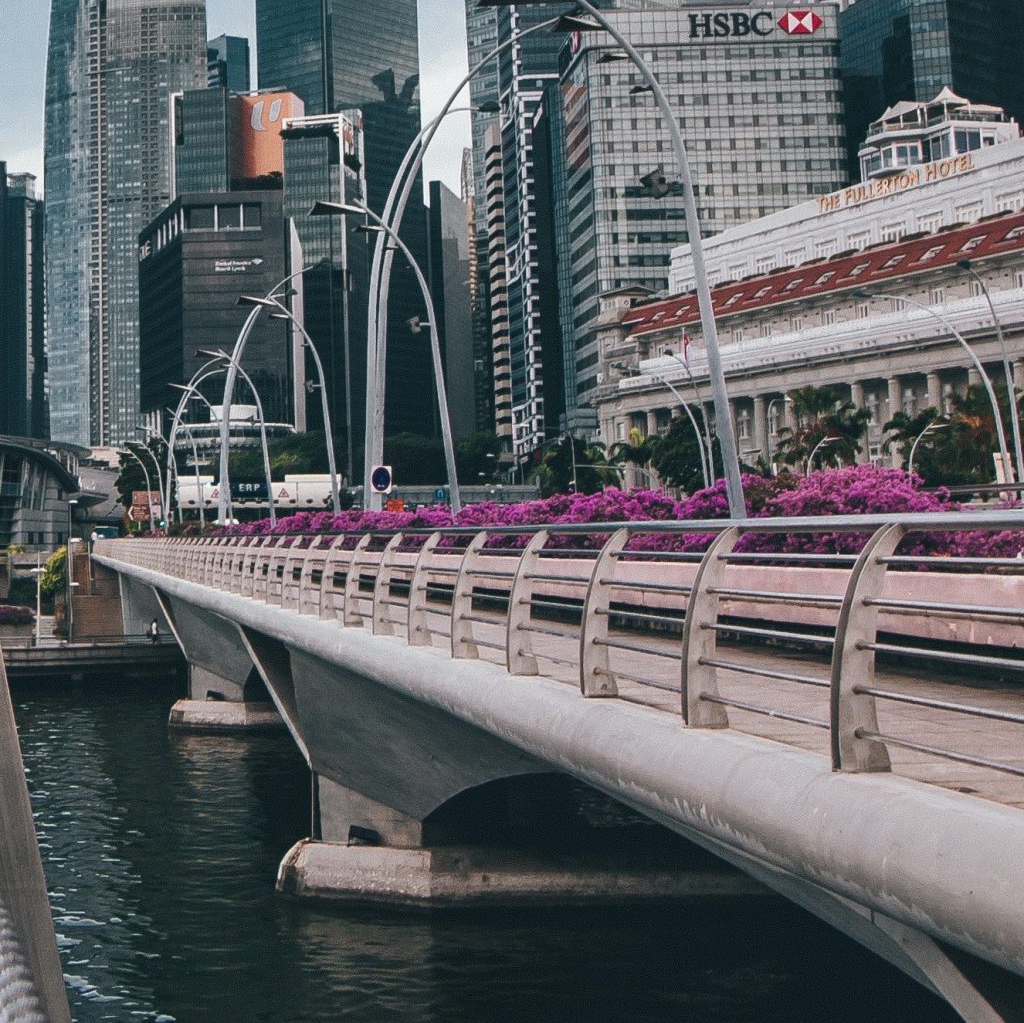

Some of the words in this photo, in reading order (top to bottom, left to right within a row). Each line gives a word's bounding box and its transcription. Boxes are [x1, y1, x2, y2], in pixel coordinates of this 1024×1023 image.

[687, 11, 774, 38] HSBC
[816, 195, 840, 213] THE
[844, 170, 920, 206] FULLERTON
[925, 153, 975, 182] HOTEL
[238, 483, 261, 492] ERP
